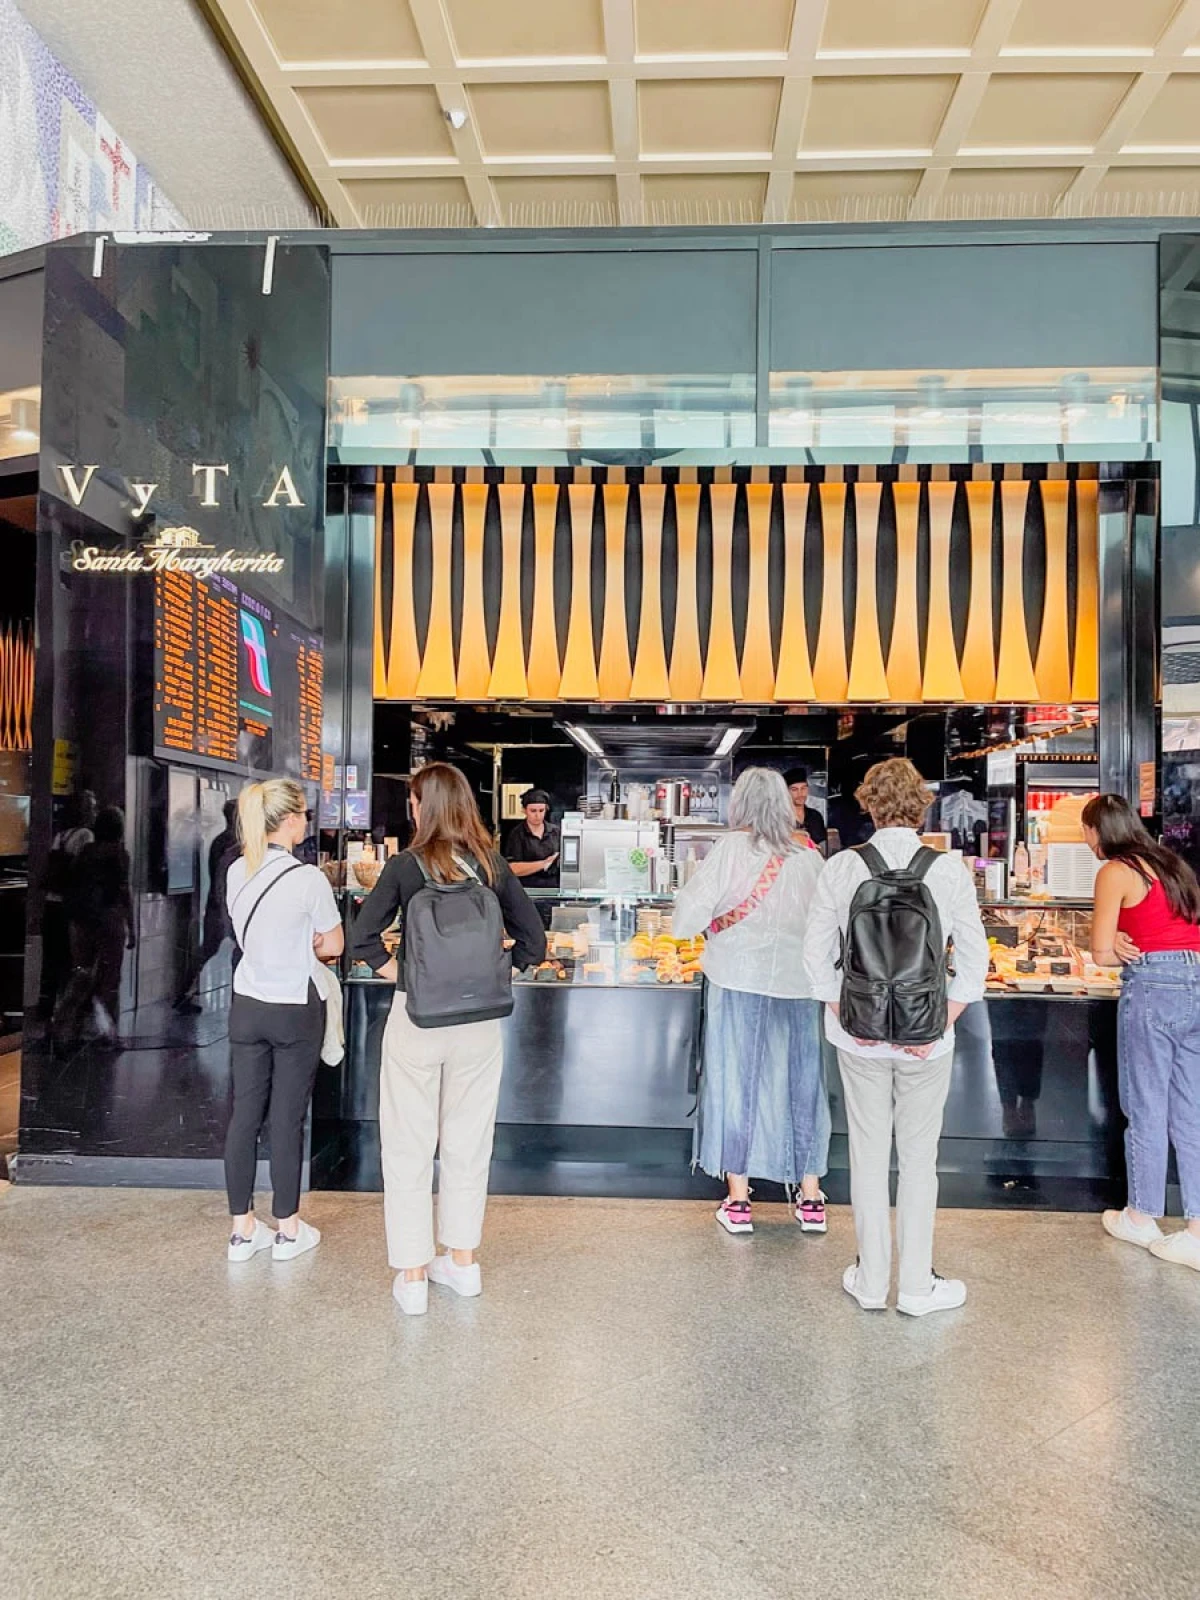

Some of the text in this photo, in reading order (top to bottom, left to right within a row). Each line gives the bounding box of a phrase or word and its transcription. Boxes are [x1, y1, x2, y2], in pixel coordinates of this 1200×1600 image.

[57, 463, 305, 517] VyTA
[74, 547, 284, 578] Santa Margherita
